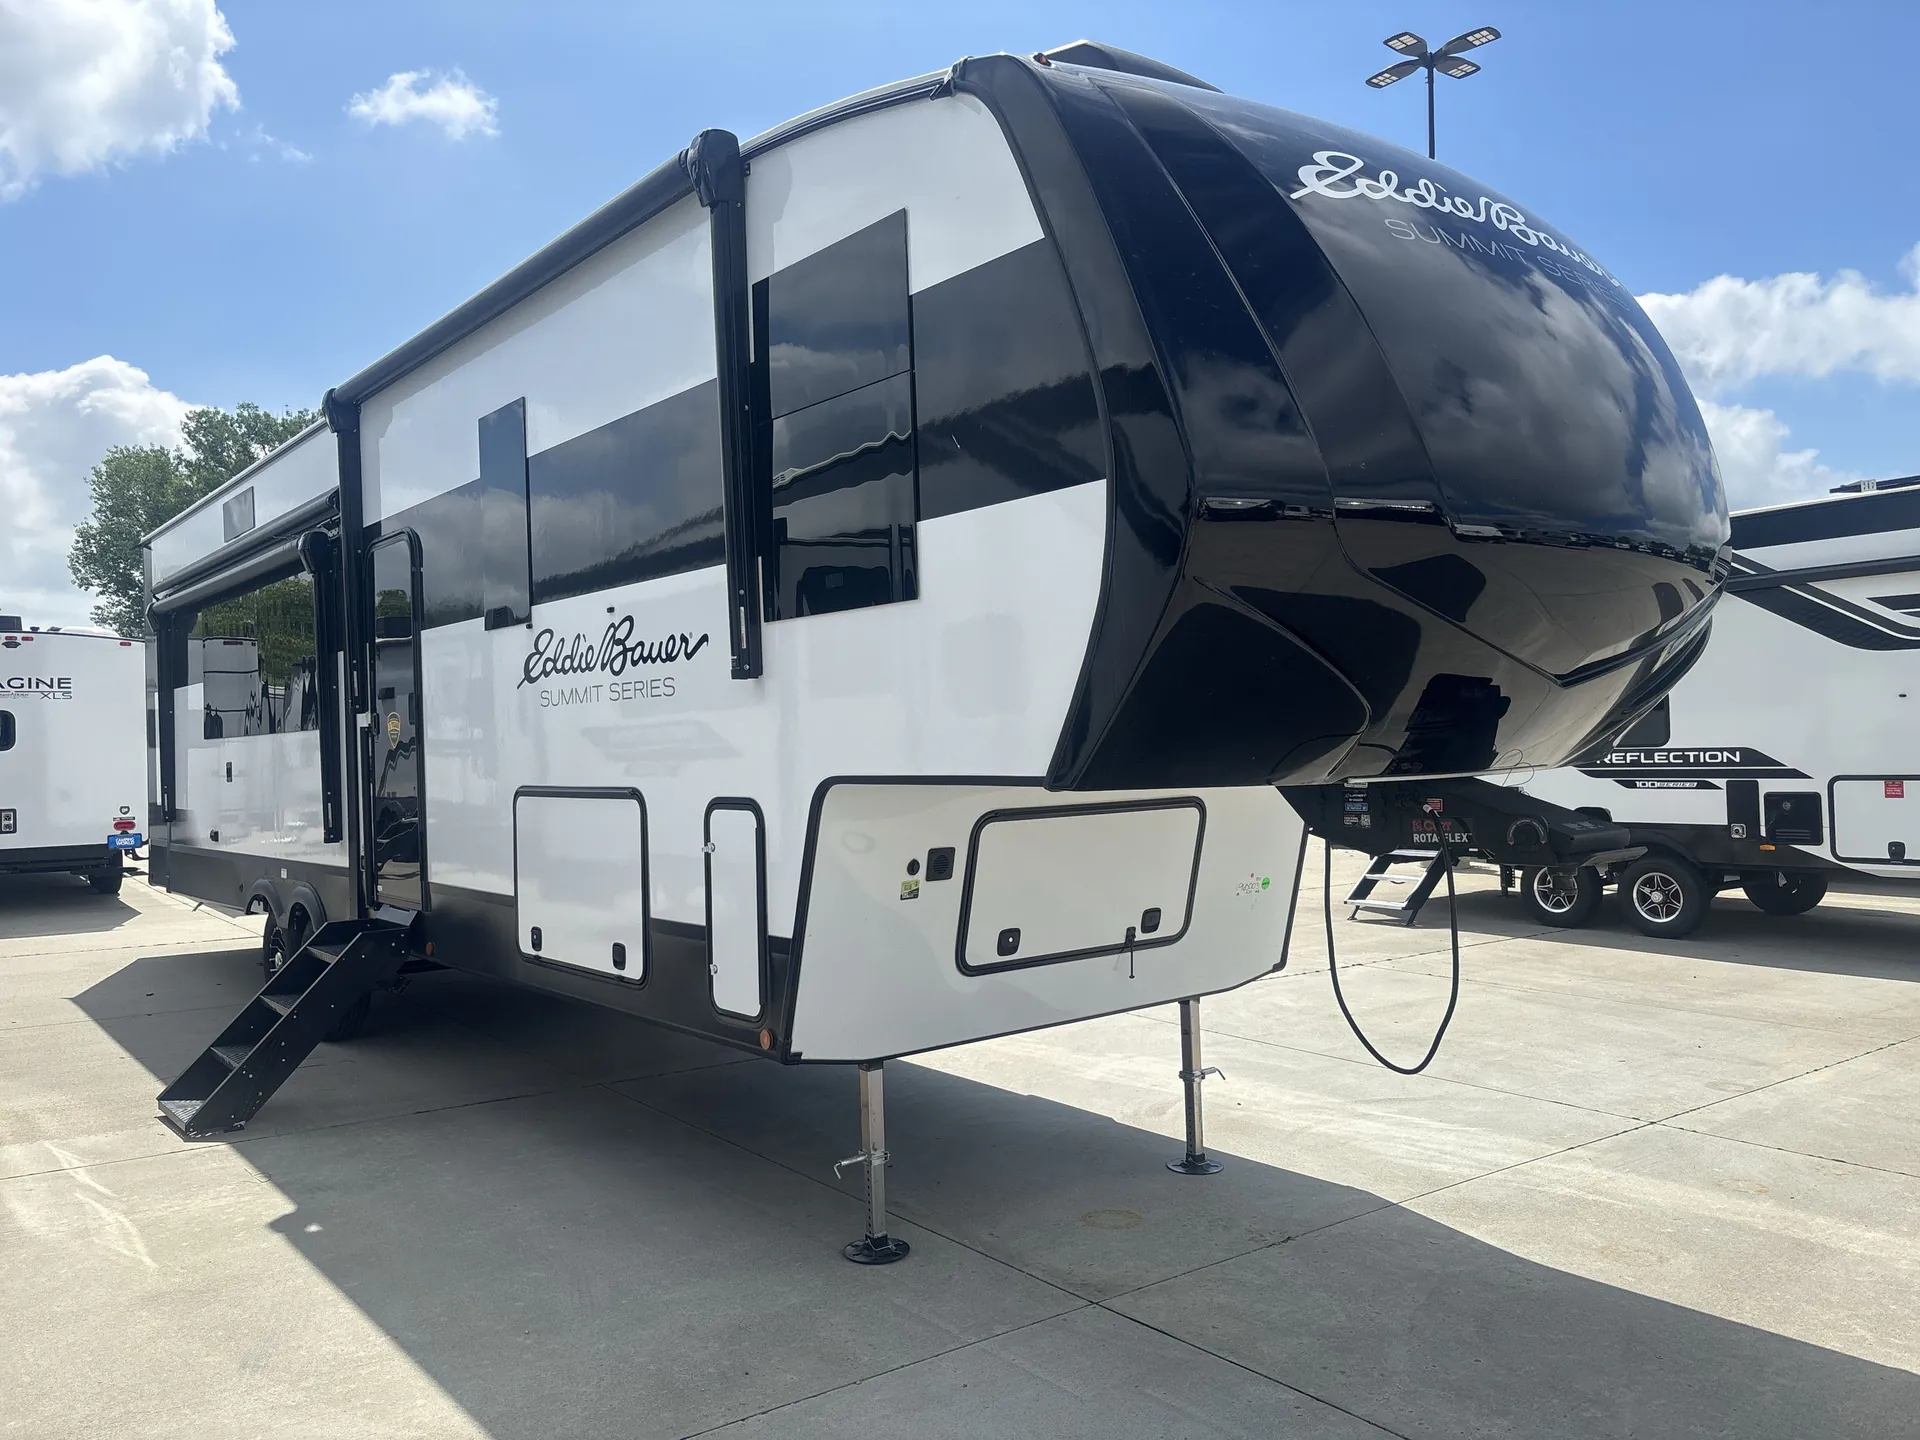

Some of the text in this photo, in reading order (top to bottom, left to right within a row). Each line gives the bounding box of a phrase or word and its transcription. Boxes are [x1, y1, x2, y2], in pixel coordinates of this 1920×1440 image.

[1290, 151, 1620, 287] Eddie Bauer
[1384, 218, 1631, 312] SUMMIT SERIES
[517, 628, 600, 690] Eddie
[600, 615, 709, 677] Bauer
[40, 691, 73, 700] XLS
[540, 677, 676, 708] SUMMIT SERIES
